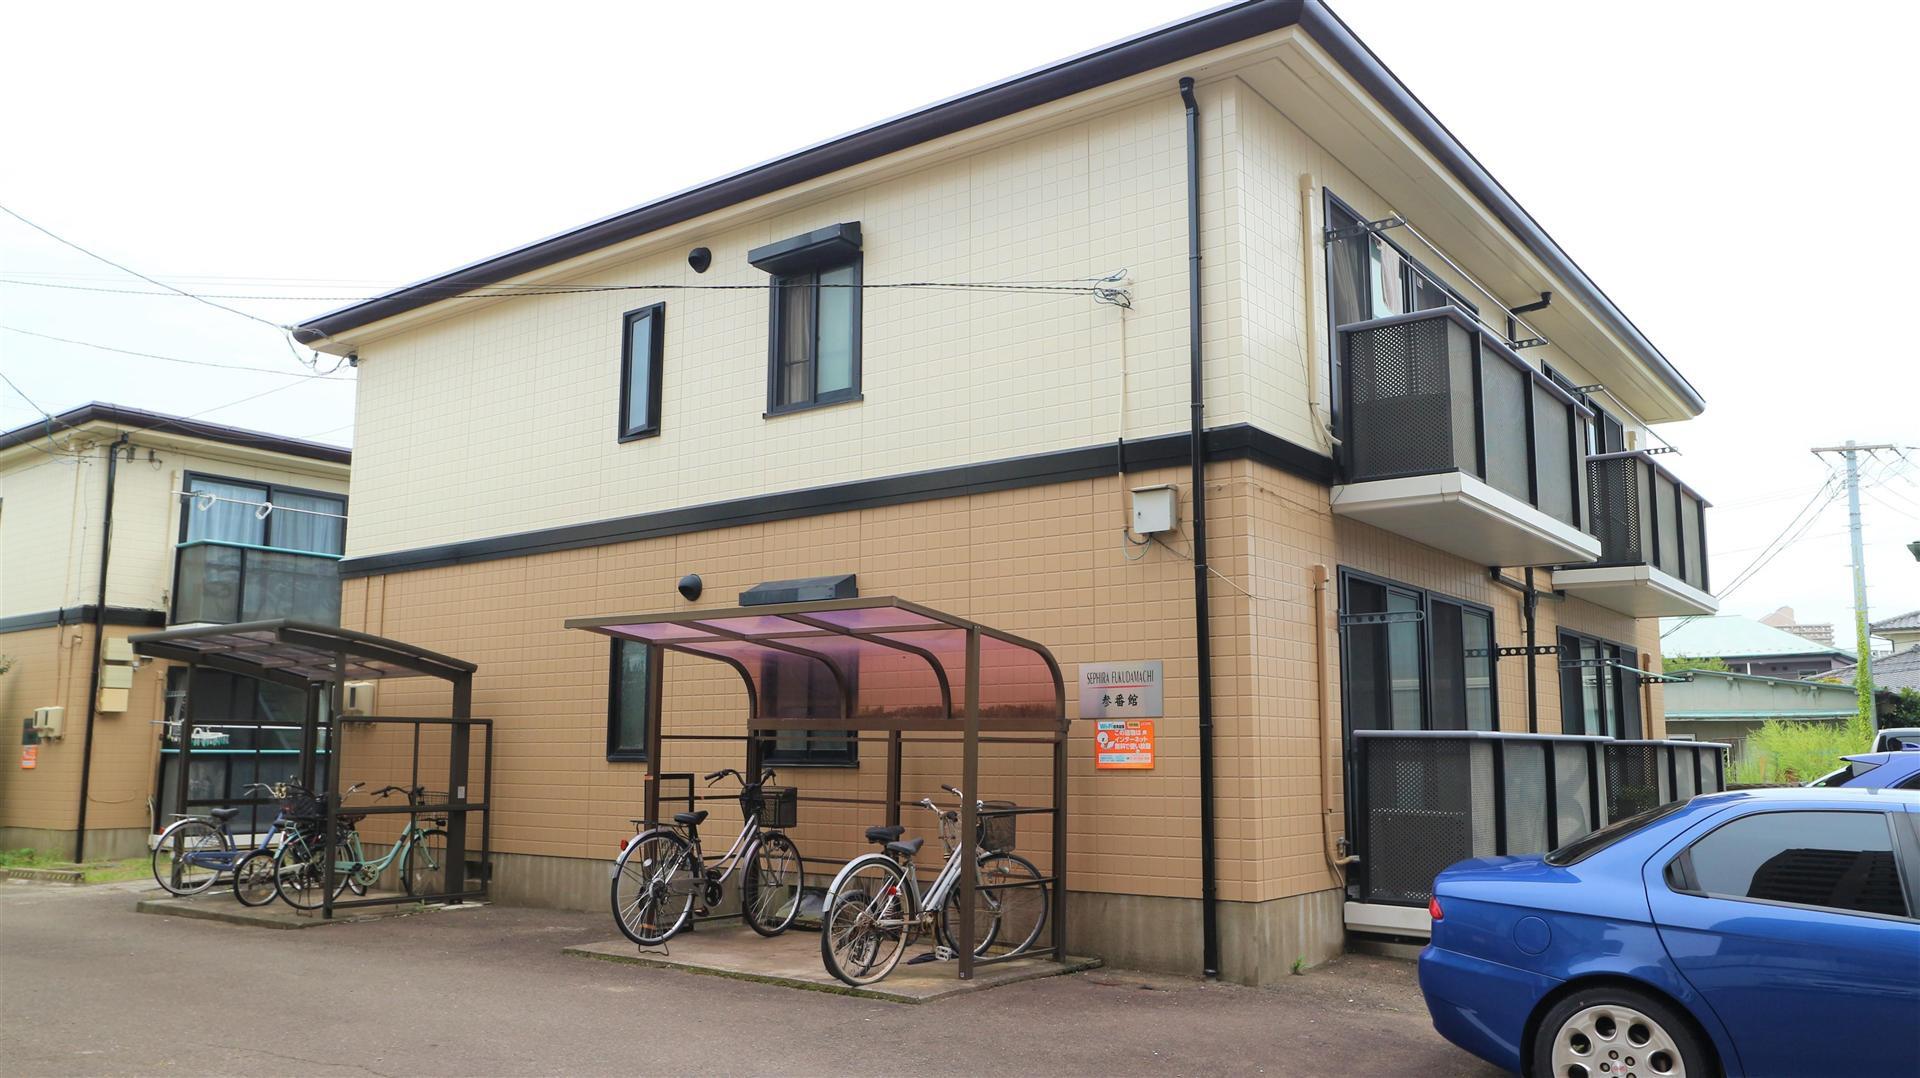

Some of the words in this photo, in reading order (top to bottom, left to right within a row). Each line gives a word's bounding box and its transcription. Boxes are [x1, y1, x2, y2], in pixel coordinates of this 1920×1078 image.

[1086, 671, 1109, 684] SEPHIRA
[1102, 693, 1138, 707] 参番館
